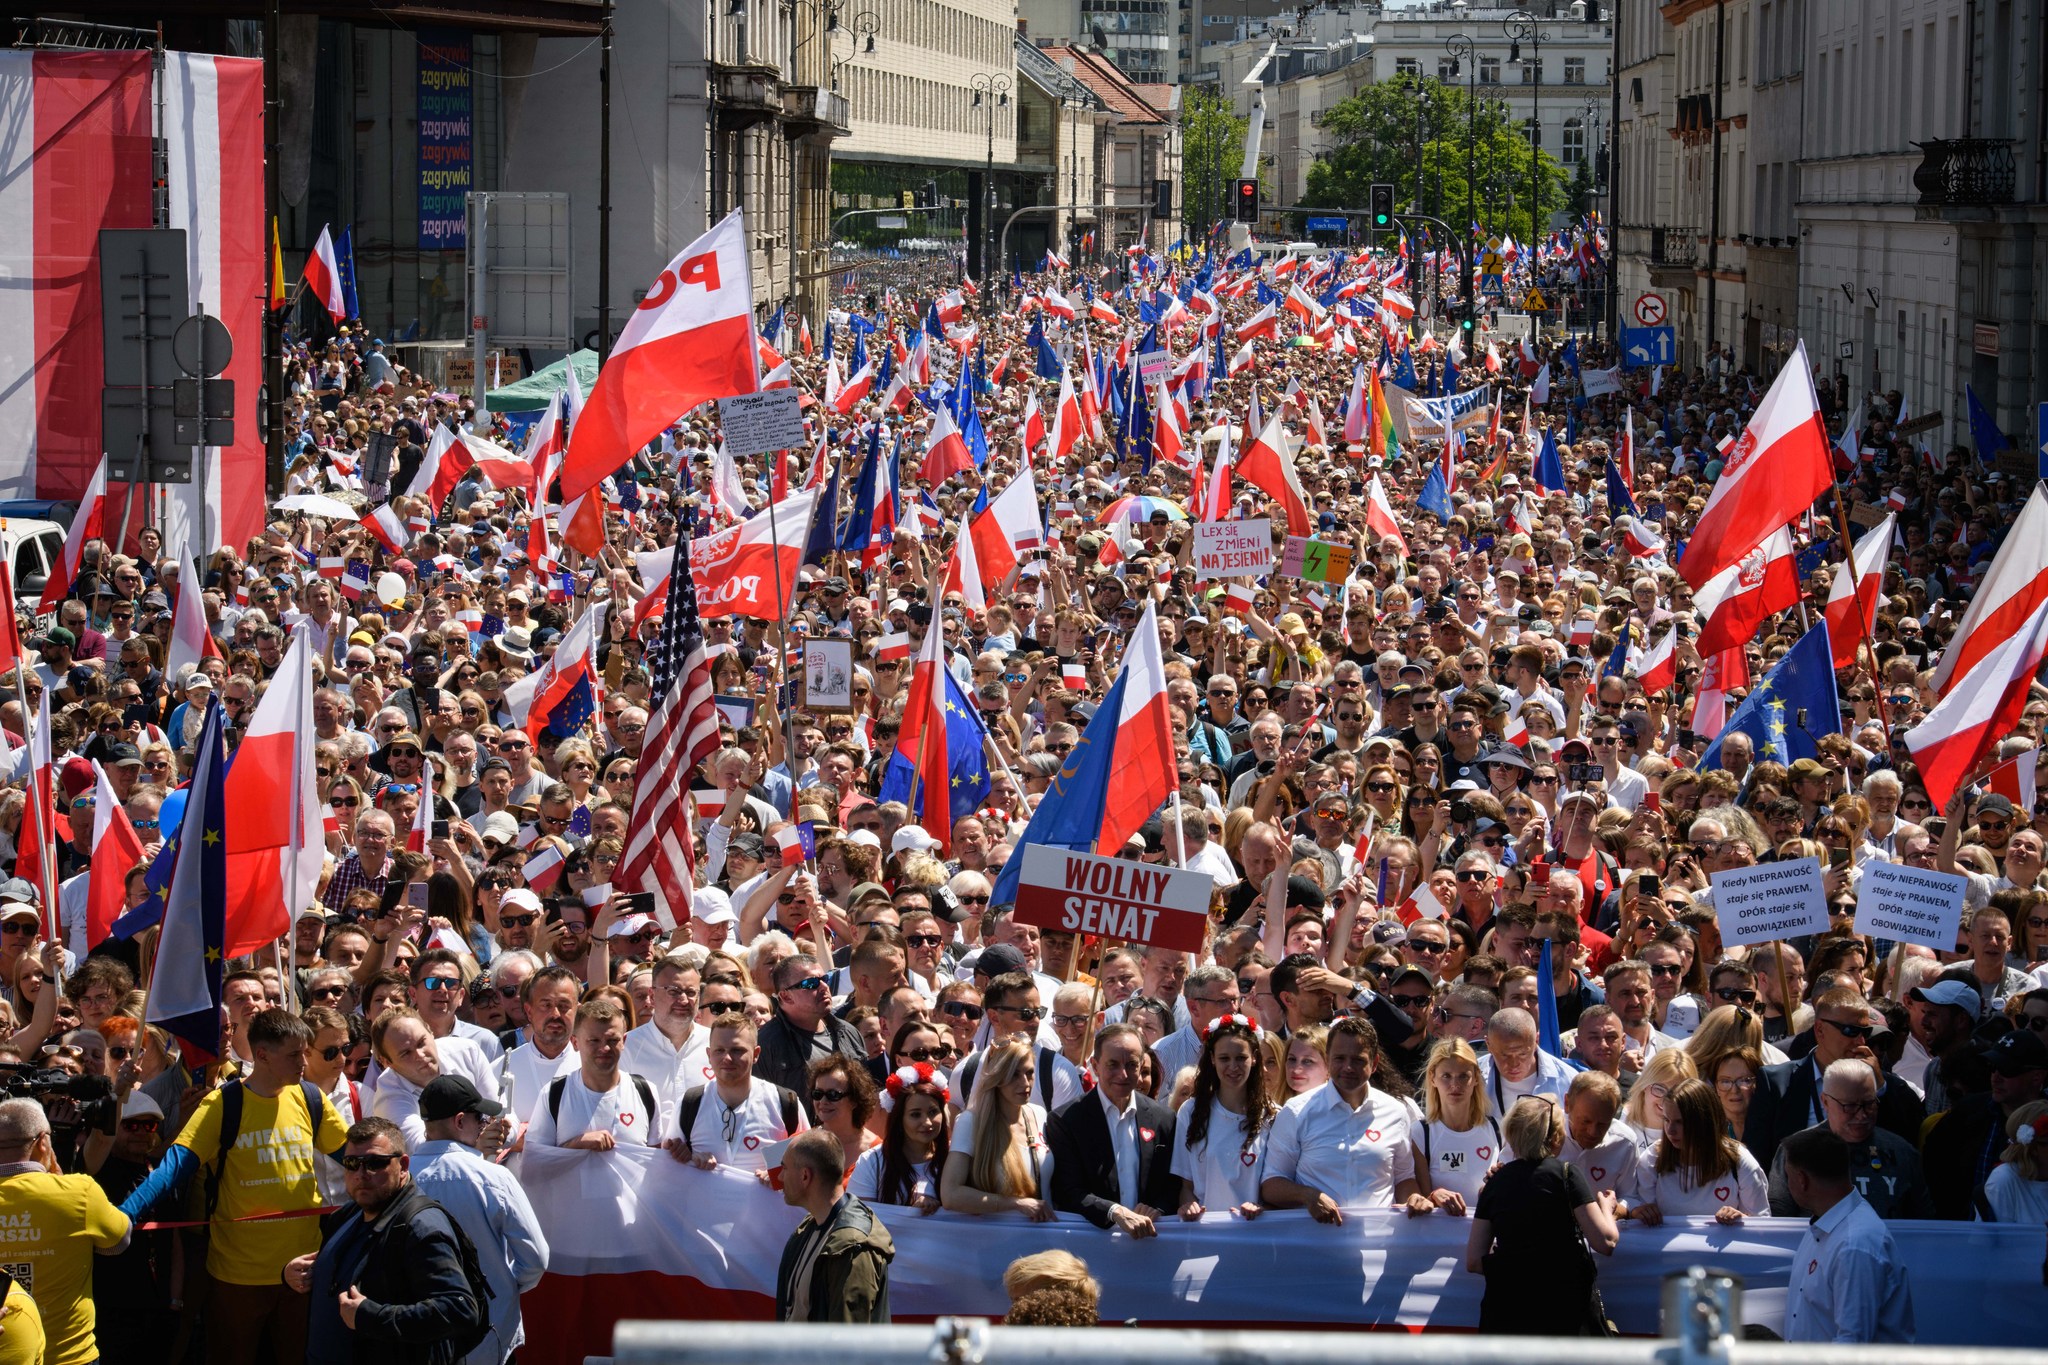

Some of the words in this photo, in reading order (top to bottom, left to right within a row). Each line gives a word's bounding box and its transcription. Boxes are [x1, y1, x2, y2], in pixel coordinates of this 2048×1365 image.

[421, 43, 469, 64] zagrywki
[421, 67, 469, 90] zagrywki
[421, 91, 469, 115] zagrywki
[421, 117, 470, 140] zagrywki
[422, 142, 470, 164] zagrywki
[422, 166, 470, 189] zagrywki
[422, 191, 466, 214] zagrywk
[422, 215, 466, 239] zagrywk
[1202, 526, 1222, 537] LEX
[1216, 536, 1260, 551] ZMIENI
[1201, 553, 1219, 569] NA
[1222, 547, 1270, 571] JESIENI!
[1065, 857, 1171, 904] WOLNY
[1722, 877, 1747, 888] Kiedy
[1750, 865, 1812, 884] NIEPRAWOŚĆ
[1873, 869, 1897, 882] Kiedy
[1898, 874, 1958, 893] NIEPRAWOŚĆ
[1726, 893, 1749, 904] staje
[1751, 890, 1763, 900] się
[1766, 883, 1812, 898] PRAWEM,
[1872, 886, 1894, 896] staje
[1894, 890, 1906, 901] się
[1908, 892, 1952, 910] PRAWEM,
[1062, 896, 1159, 942] SENAT
[1739, 906, 1766, 918] OPÓR
[1768, 903, 1790, 914] staje
[1793, 901, 1805, 910] się
[1878, 902, 1903, 915] OPÓR
[1904, 908, 1926, 920] staje
[1928, 913, 1940, 924] się
[1737, 917, 1806, 935] OBOWIĄZKIEM
[1871, 918, 1936, 938] OBOWIĄZKIEM
[235, 1125, 302, 1149] WIELKI
[257, 1143, 313, 1164] MARS
[245, 1177, 281, 1186] czerwca
[12, 1250, 41, 1258] zapisz
